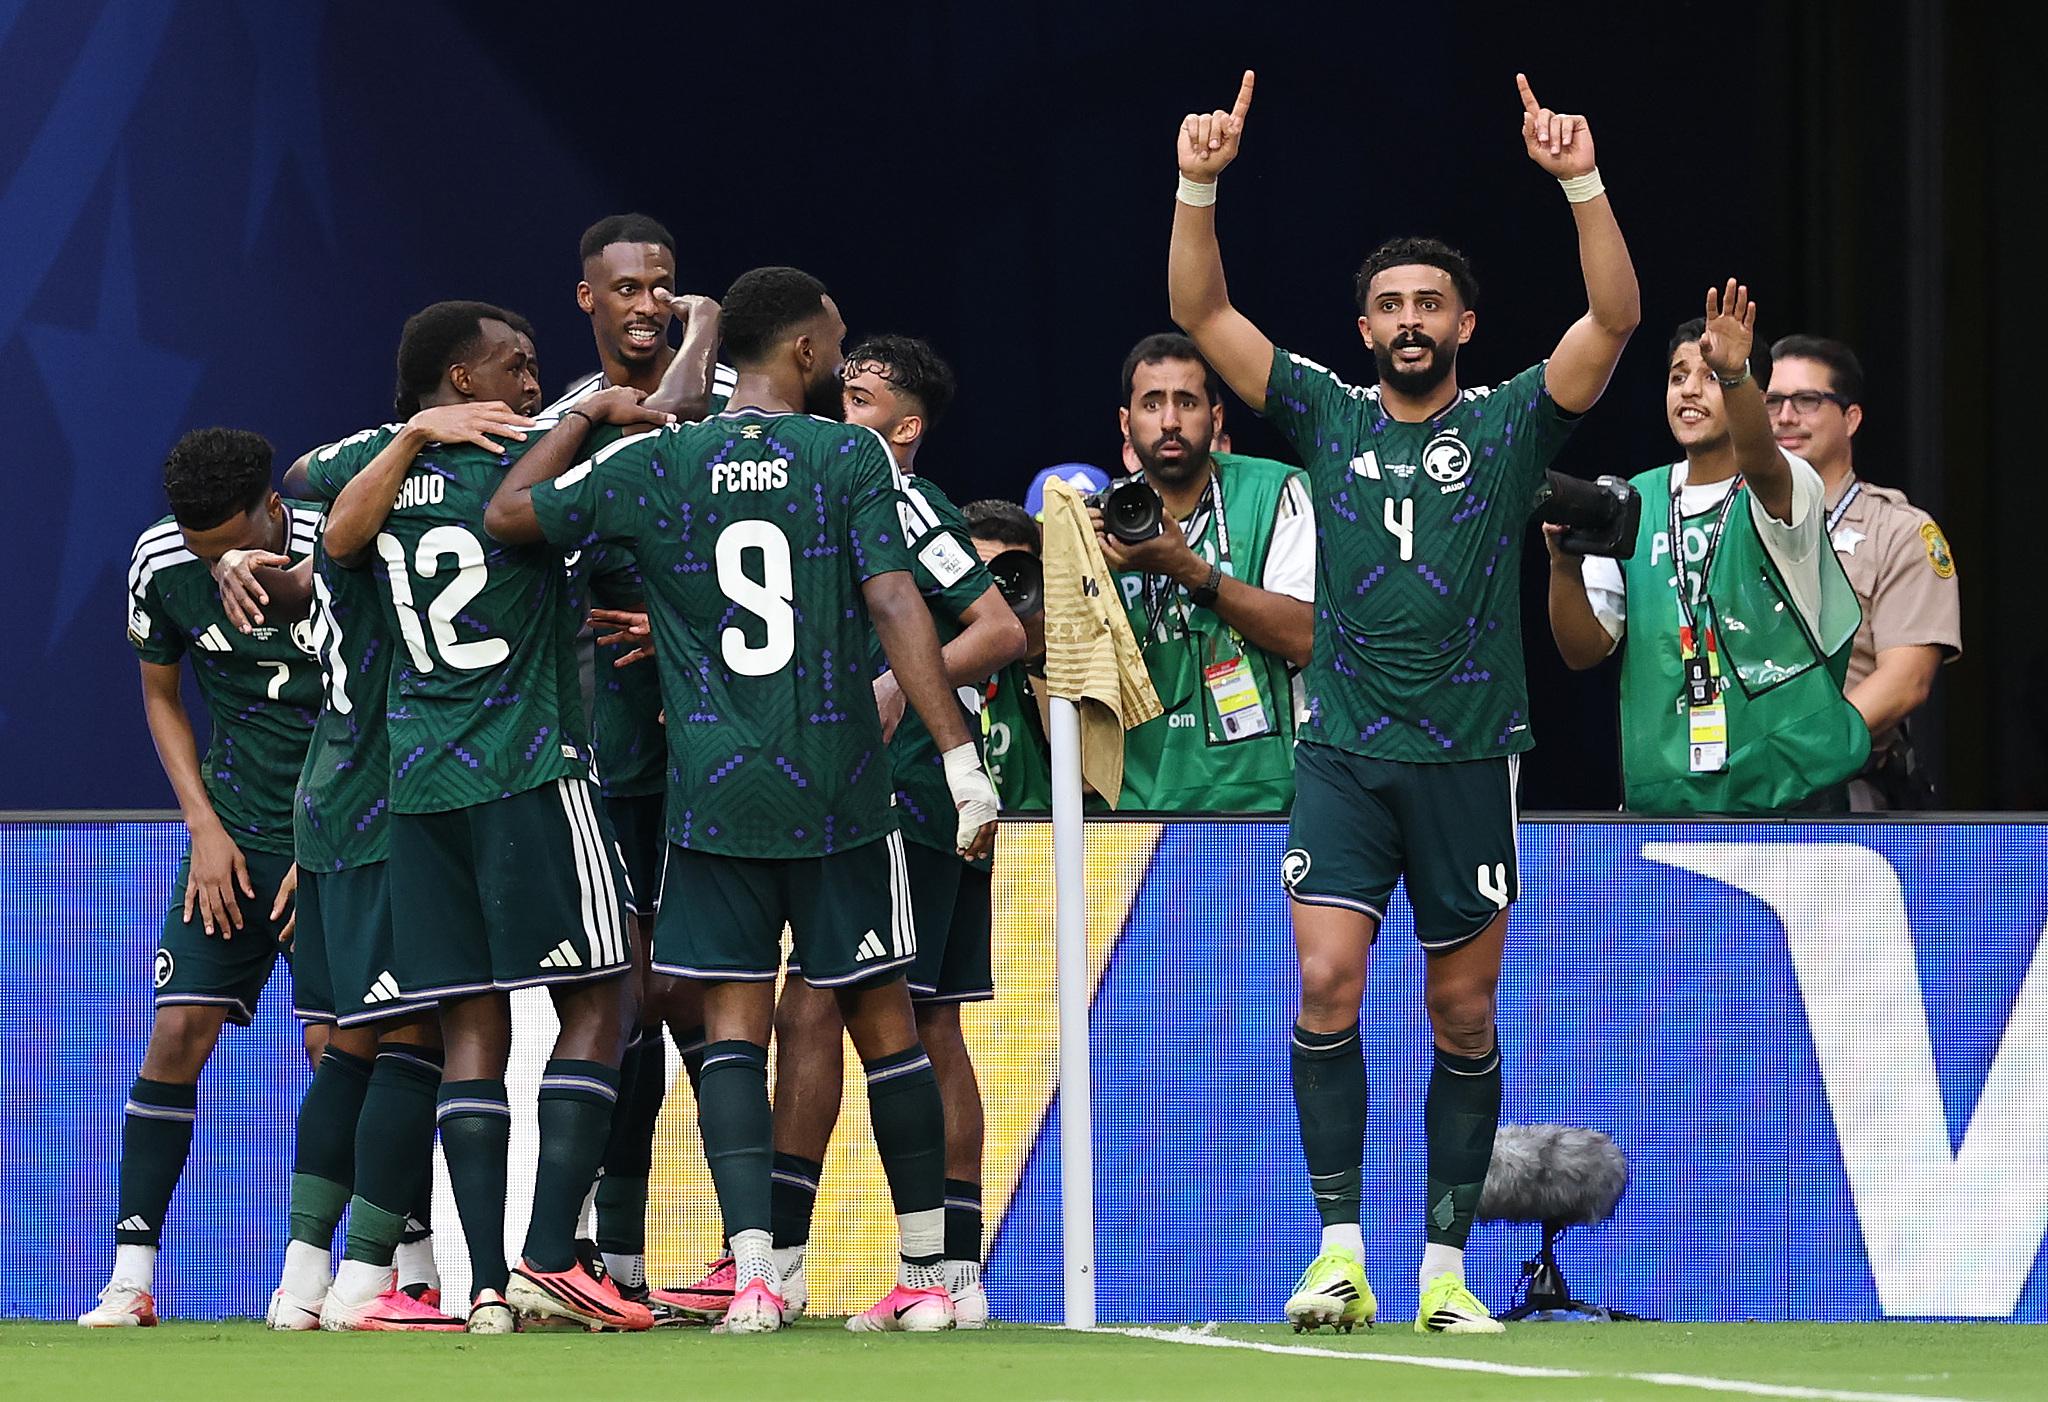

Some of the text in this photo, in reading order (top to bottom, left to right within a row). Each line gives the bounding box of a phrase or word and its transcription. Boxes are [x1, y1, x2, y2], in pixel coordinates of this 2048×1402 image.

[711, 457, 788, 494] FERAS
[1440, 481, 1466, 494] SAUDI
[1384, 497, 1413, 561] 4
[377, 525, 510, 674] 12
[715, 519, 795, 677] 9
[256, 661, 290, 700] 7
[1478, 863, 1508, 910] 4
